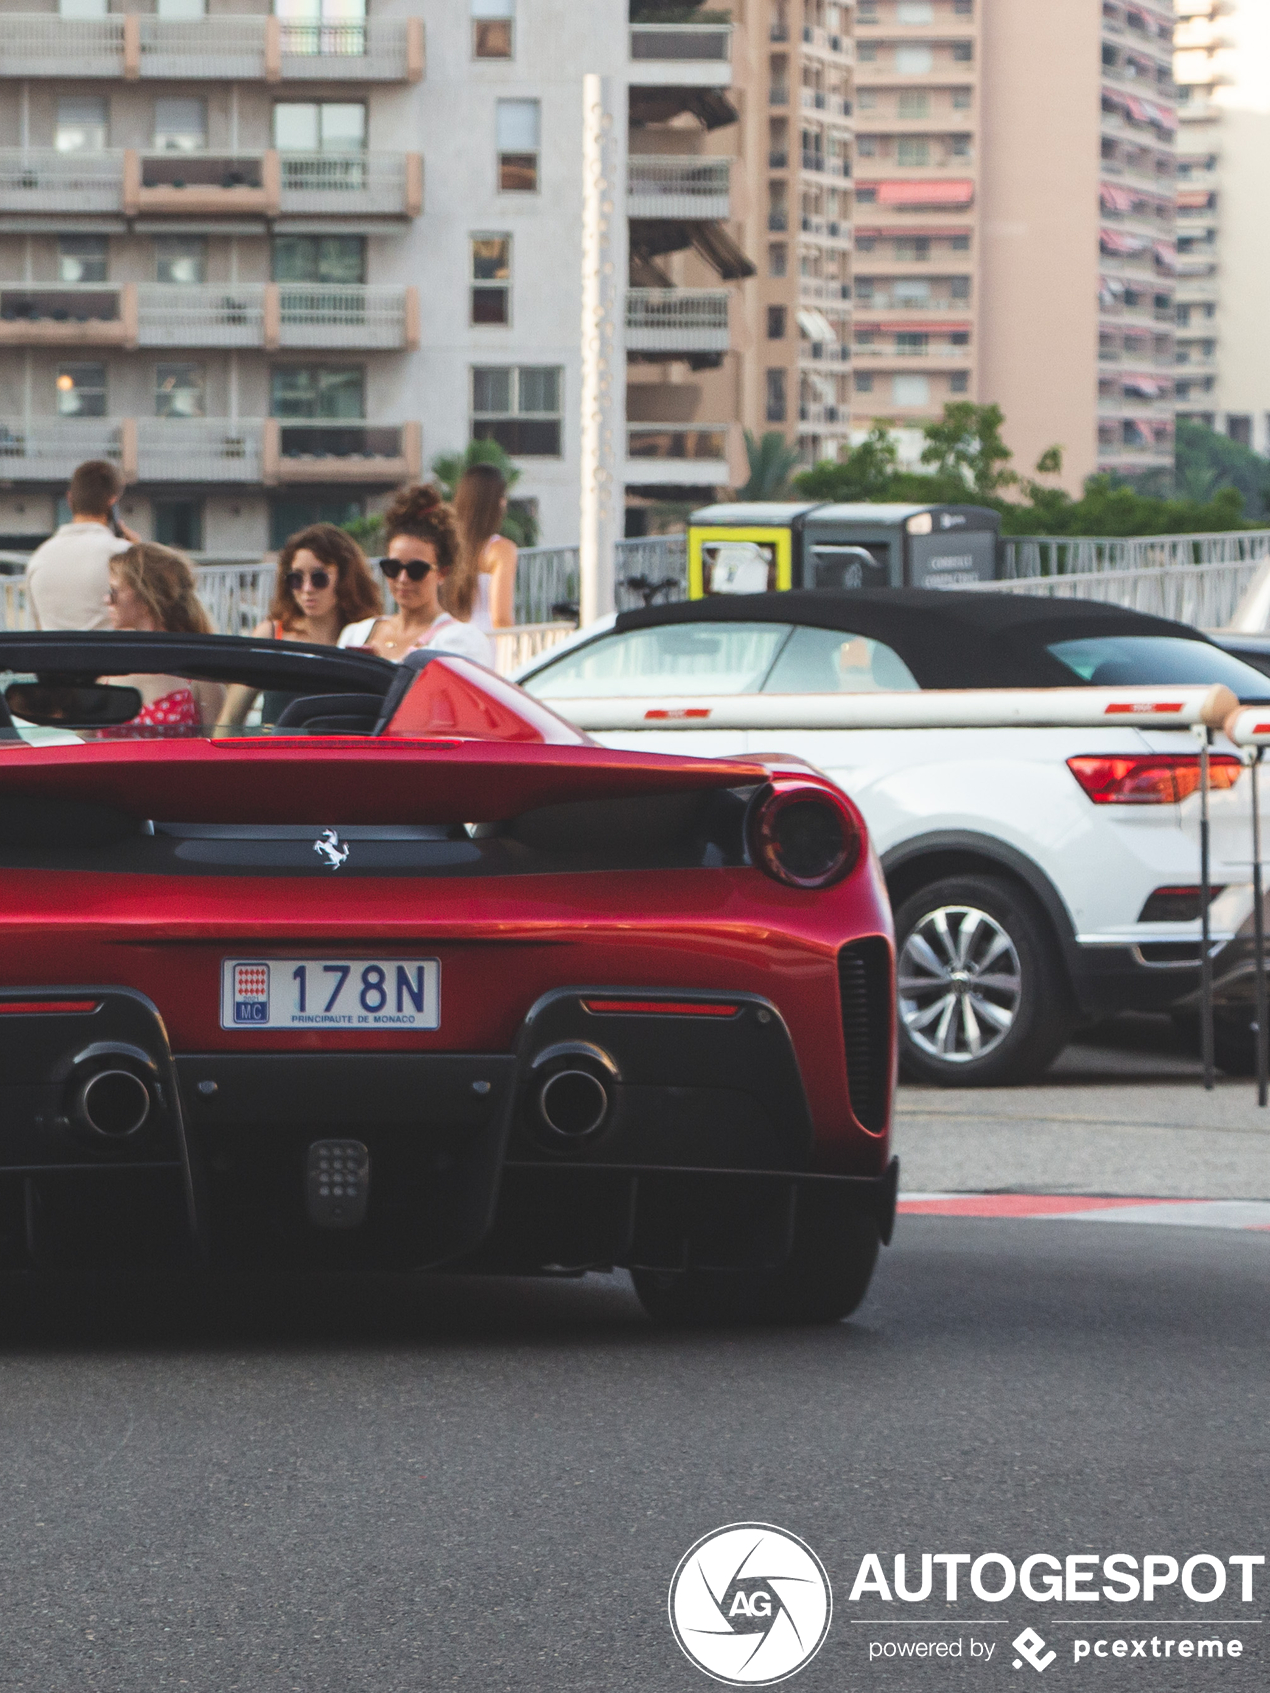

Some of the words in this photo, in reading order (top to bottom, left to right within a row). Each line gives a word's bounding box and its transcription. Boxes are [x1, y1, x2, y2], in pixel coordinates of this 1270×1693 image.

[293, 964, 425, 1013] 178N
[241, 1004, 262, 1020] MC
[291, 1014, 354, 1024] PRINCIPAUTE
[357, 1014, 370, 1024] DE
[373, 1014, 416, 1024] MONACO
